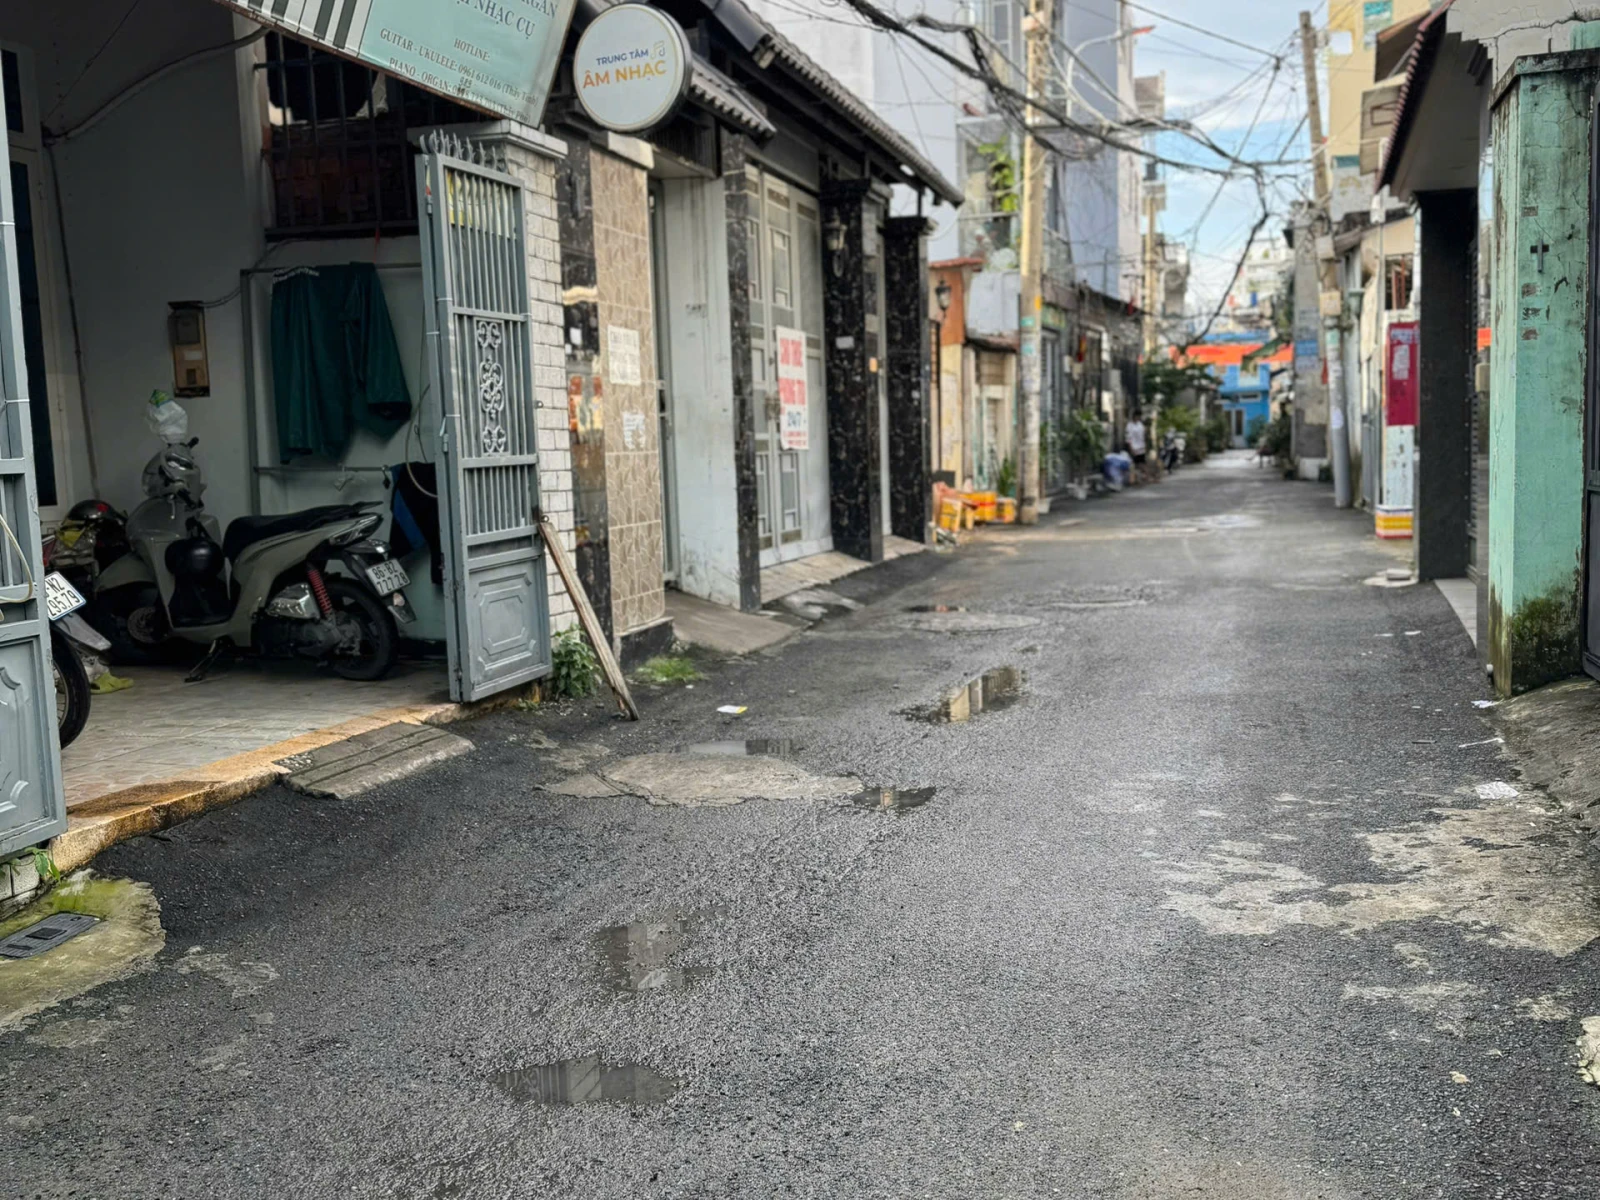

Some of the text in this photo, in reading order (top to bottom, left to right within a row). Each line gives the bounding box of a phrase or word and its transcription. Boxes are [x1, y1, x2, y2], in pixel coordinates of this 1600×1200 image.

[474, 0, 536, 40] NHẠC CỤ
[379, 28, 414, 52] GUITAR
[418, 45, 458, 72] UKULELE:
[458, 63, 475, 79] 0961
[476, 71, 490, 85] 612
[489, 78, 502, 91] 016
[453, 38, 490, 62] HOTLINE:
[596, 47, 649, 66] TRUNG TÂM
[389, 56, 416, 77] PIANO
[421, 71, 451, 92] ORGAN:
[582, 60, 667, 89] ÂM NHẠC
